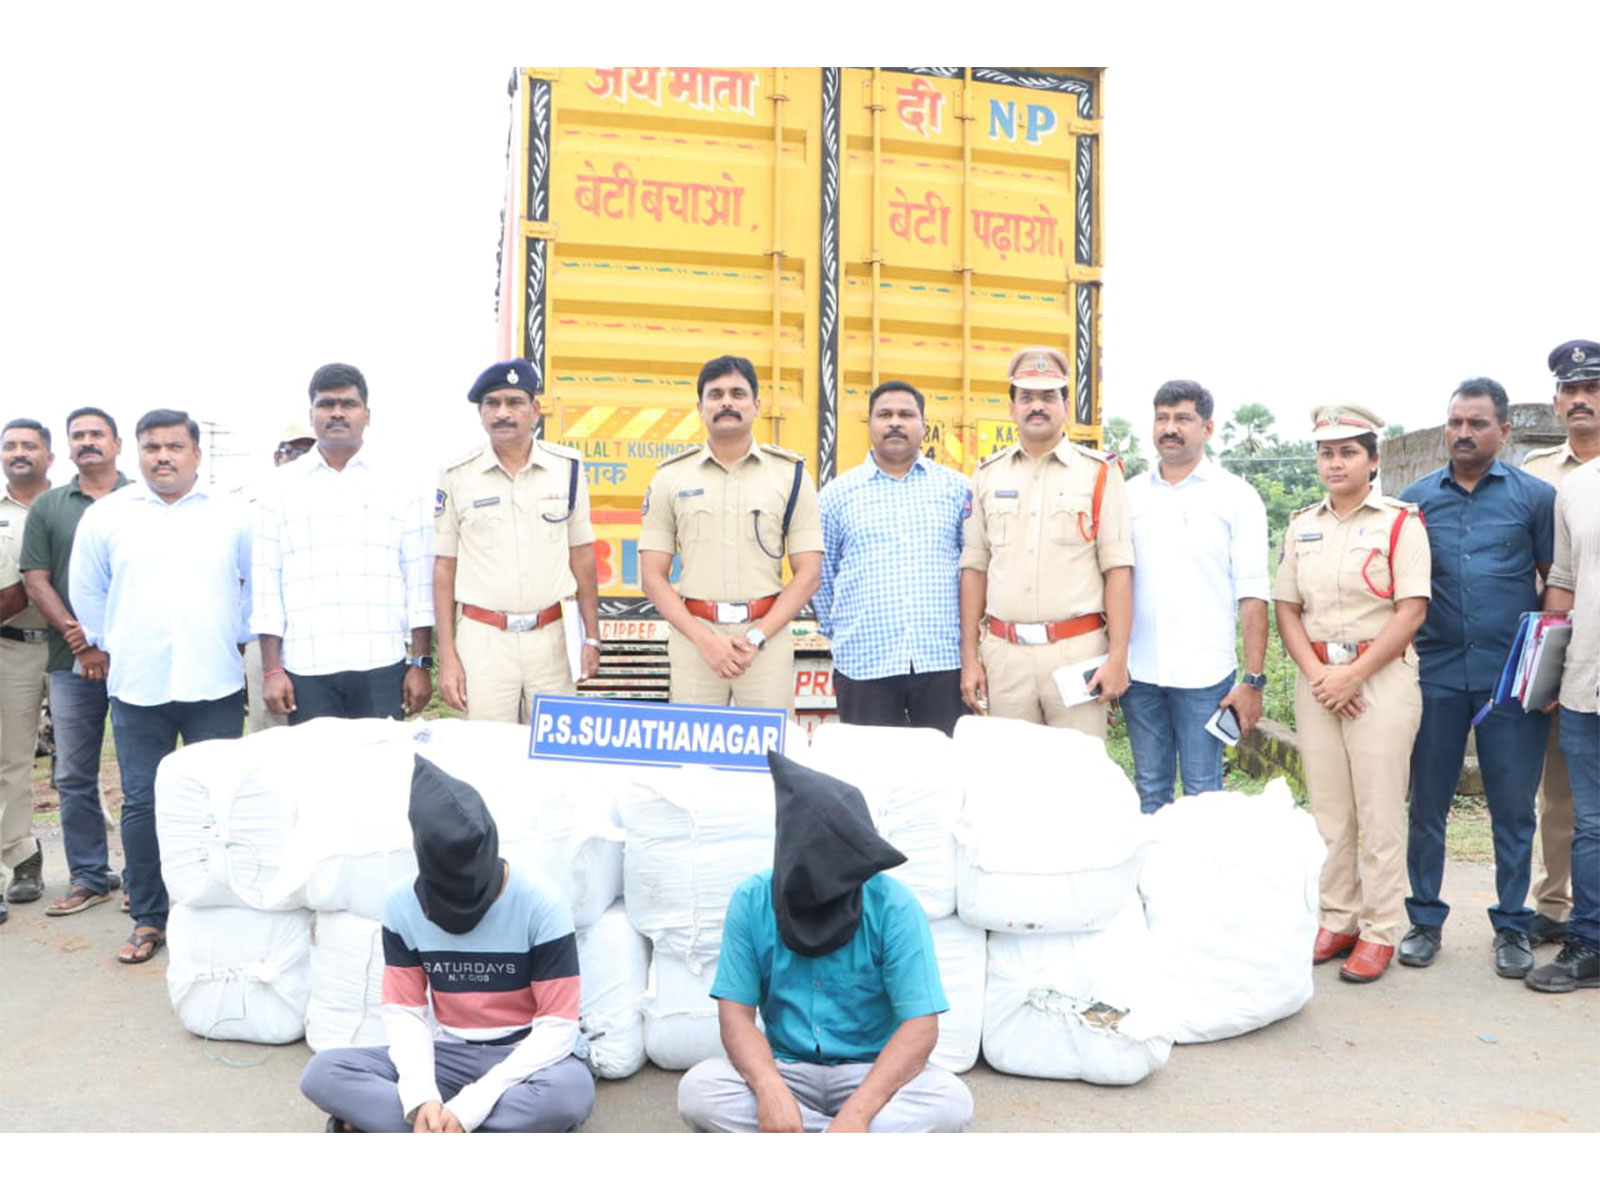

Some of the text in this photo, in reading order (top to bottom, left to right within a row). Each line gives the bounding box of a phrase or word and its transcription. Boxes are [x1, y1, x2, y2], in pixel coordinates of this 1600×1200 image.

[896, 78, 947, 138] दी
[573, 159, 640, 220] बेटी
[888, 187, 951, 246] बेटी
[613, 441, 622, 457] T
[795, 670, 837, 697] PR
[536, 713, 780, 756] P.S.SUJATHANAGAR
[423, 961, 517, 975] SATURDAYS
